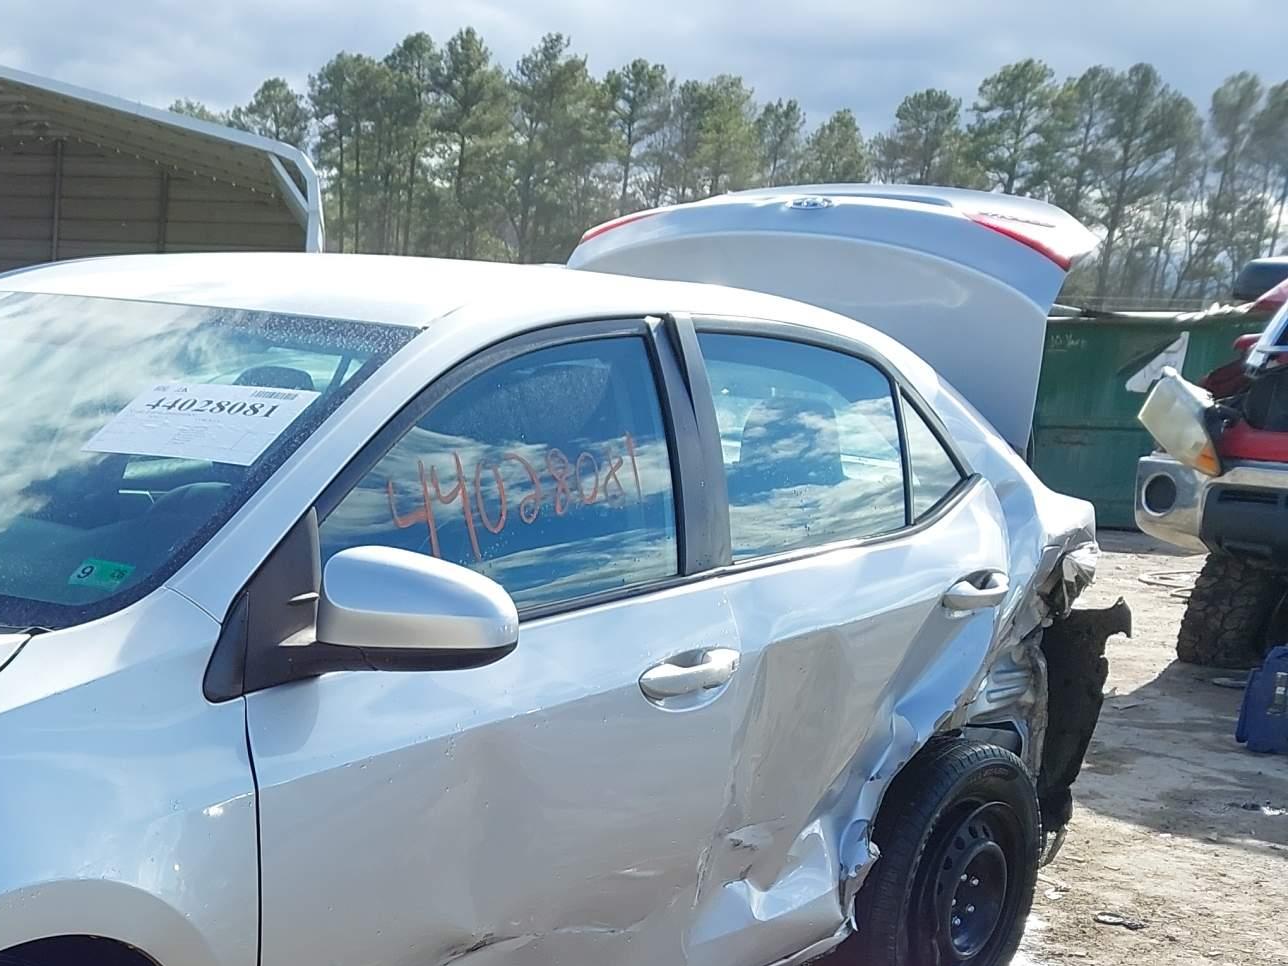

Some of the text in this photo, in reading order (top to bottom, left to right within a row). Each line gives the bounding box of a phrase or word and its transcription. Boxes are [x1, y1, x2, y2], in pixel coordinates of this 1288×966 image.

[145, 396, 280, 418] 44028081
[386, 430, 643, 563] 44028081
[76, 565, 95, 579] 9
